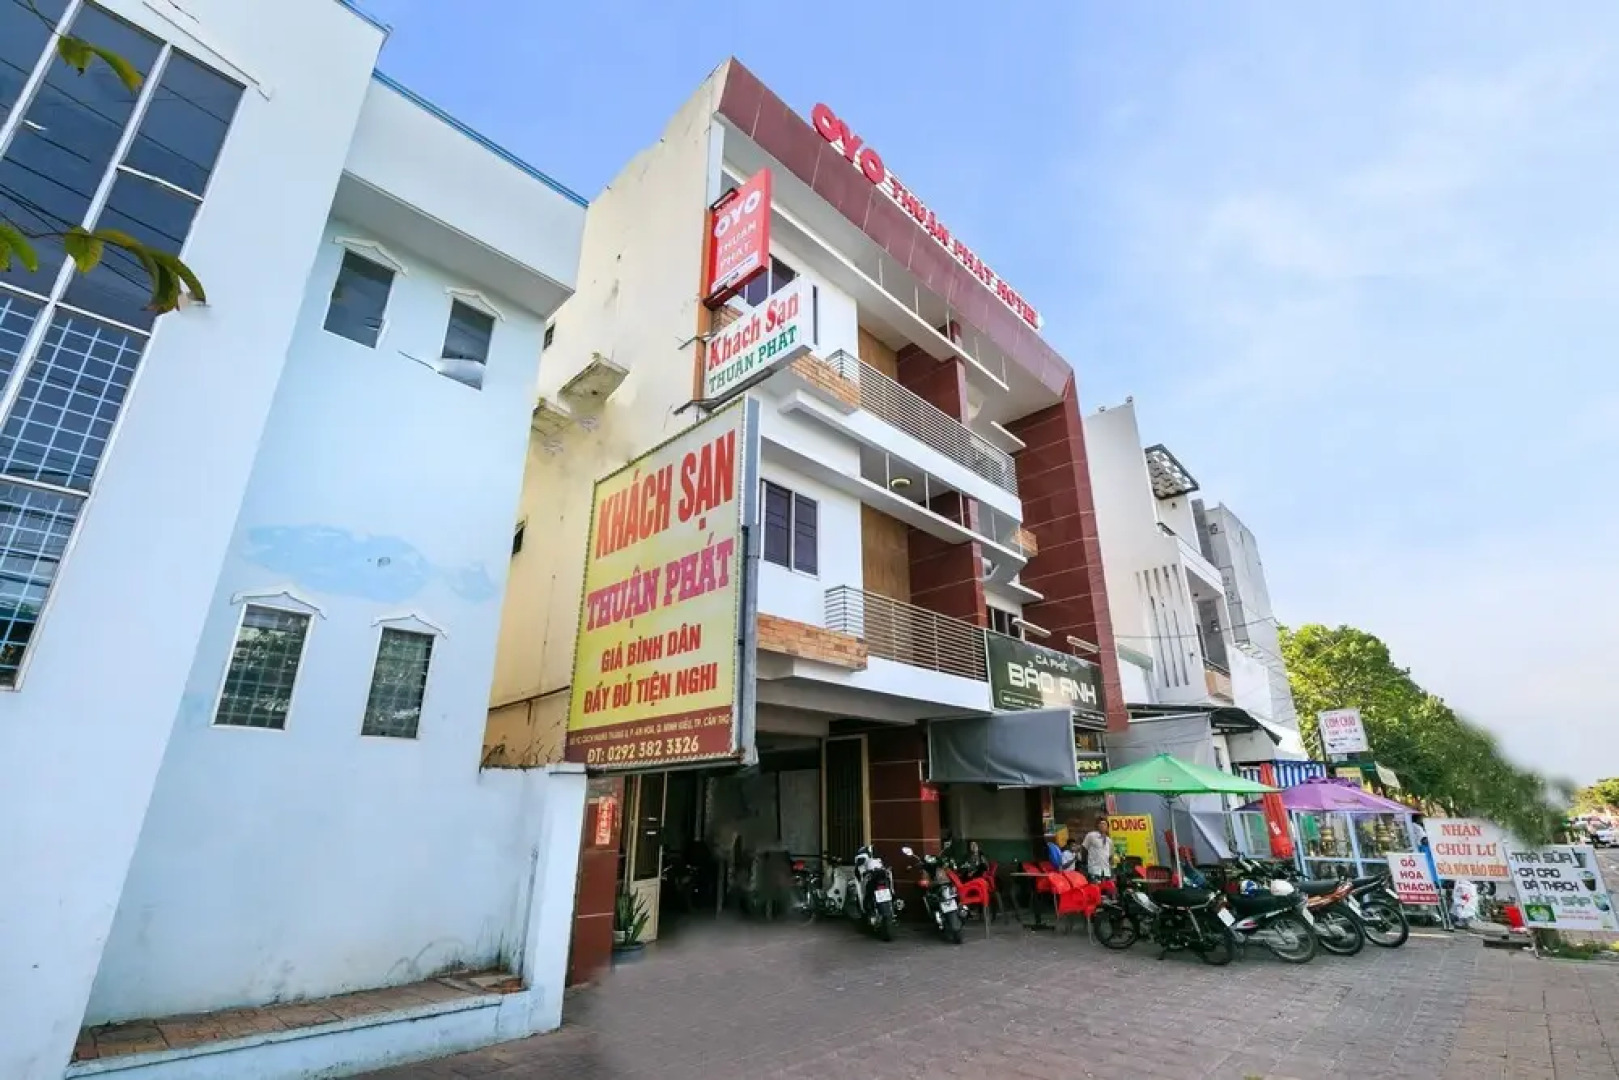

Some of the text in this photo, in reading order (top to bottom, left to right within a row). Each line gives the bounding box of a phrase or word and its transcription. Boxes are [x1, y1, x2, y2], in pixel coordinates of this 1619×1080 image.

[811, 103, 885, 184] OYO
[714, 190, 761, 238] OYO
[595, 428, 736, 560] KHÁCH SẠN
[586, 531, 734, 632] THUẬN PHÁT
[601, 640, 623, 673] GIÁ
[666, 622, 703, 657] DÂN
[636, 670, 672, 707] TIỆN
[675, 662, 719, 697] NGHI
[1007, 661, 1055, 694] BẢO
[1059, 676, 1097, 705] ANH
[607, 743, 636, 761] 0292
[666, 735, 699, 754] 3326
